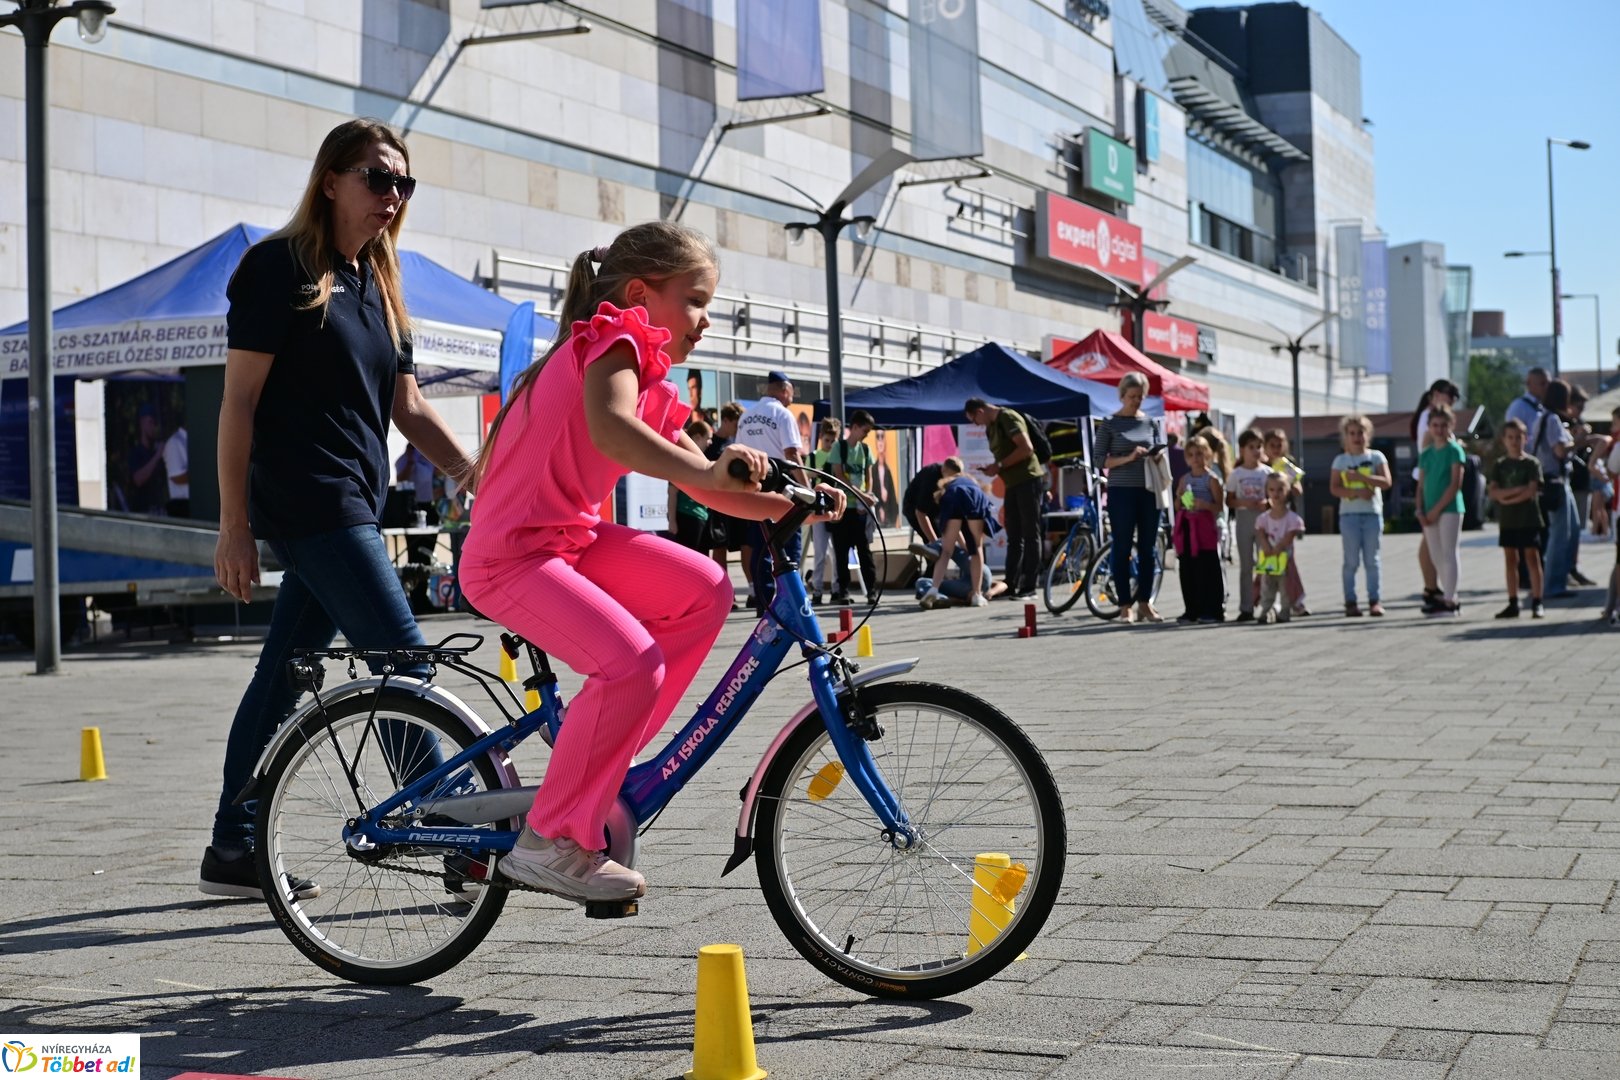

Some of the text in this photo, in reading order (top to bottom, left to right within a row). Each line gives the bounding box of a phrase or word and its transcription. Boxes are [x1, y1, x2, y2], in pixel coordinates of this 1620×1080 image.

[1056, 220, 1138, 264] expert digital
[172, 343, 228, 361] BIZOTT
[661, 757, 681, 780] AZ
[677, 717, 719, 761] ISKOLA
[408, 832, 481, 844] NEUZER
[821, 955, 874, 985] CONTACT
